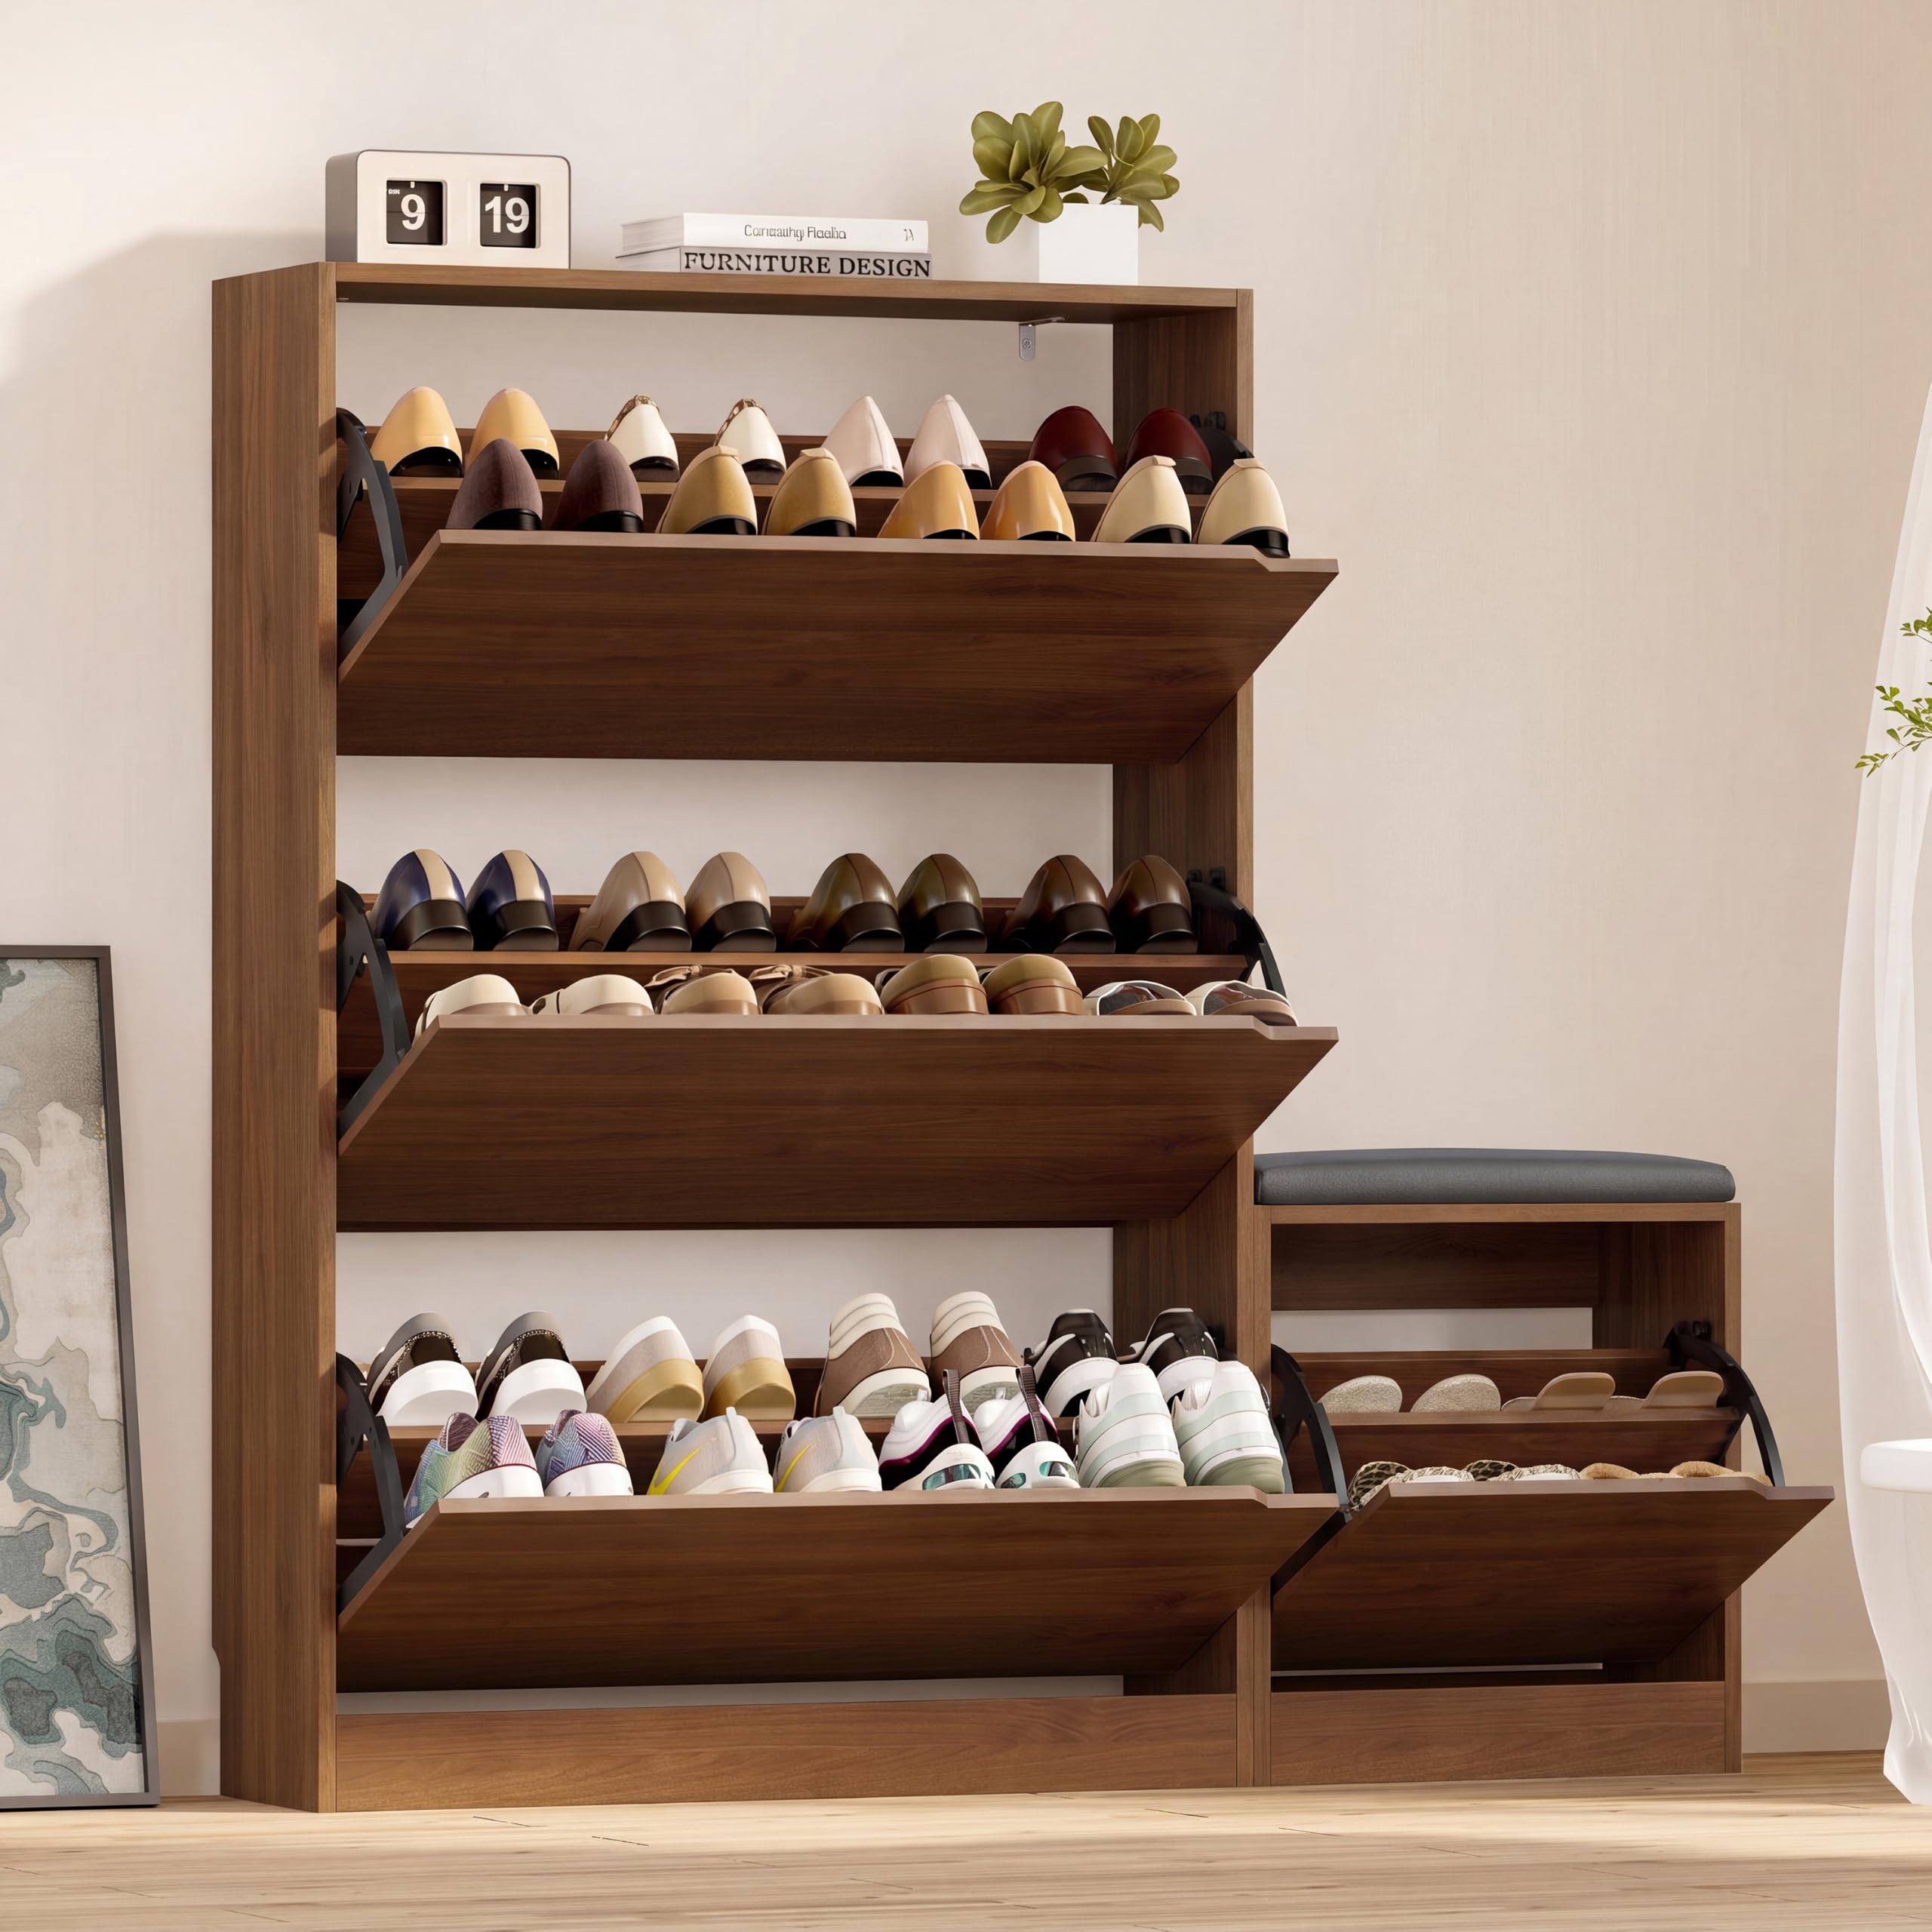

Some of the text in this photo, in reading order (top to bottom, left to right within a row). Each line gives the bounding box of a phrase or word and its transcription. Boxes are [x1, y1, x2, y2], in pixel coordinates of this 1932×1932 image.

[401, 194, 530, 234] 9 19
[684, 252, 931, 277] FURNITURE DESIGN
